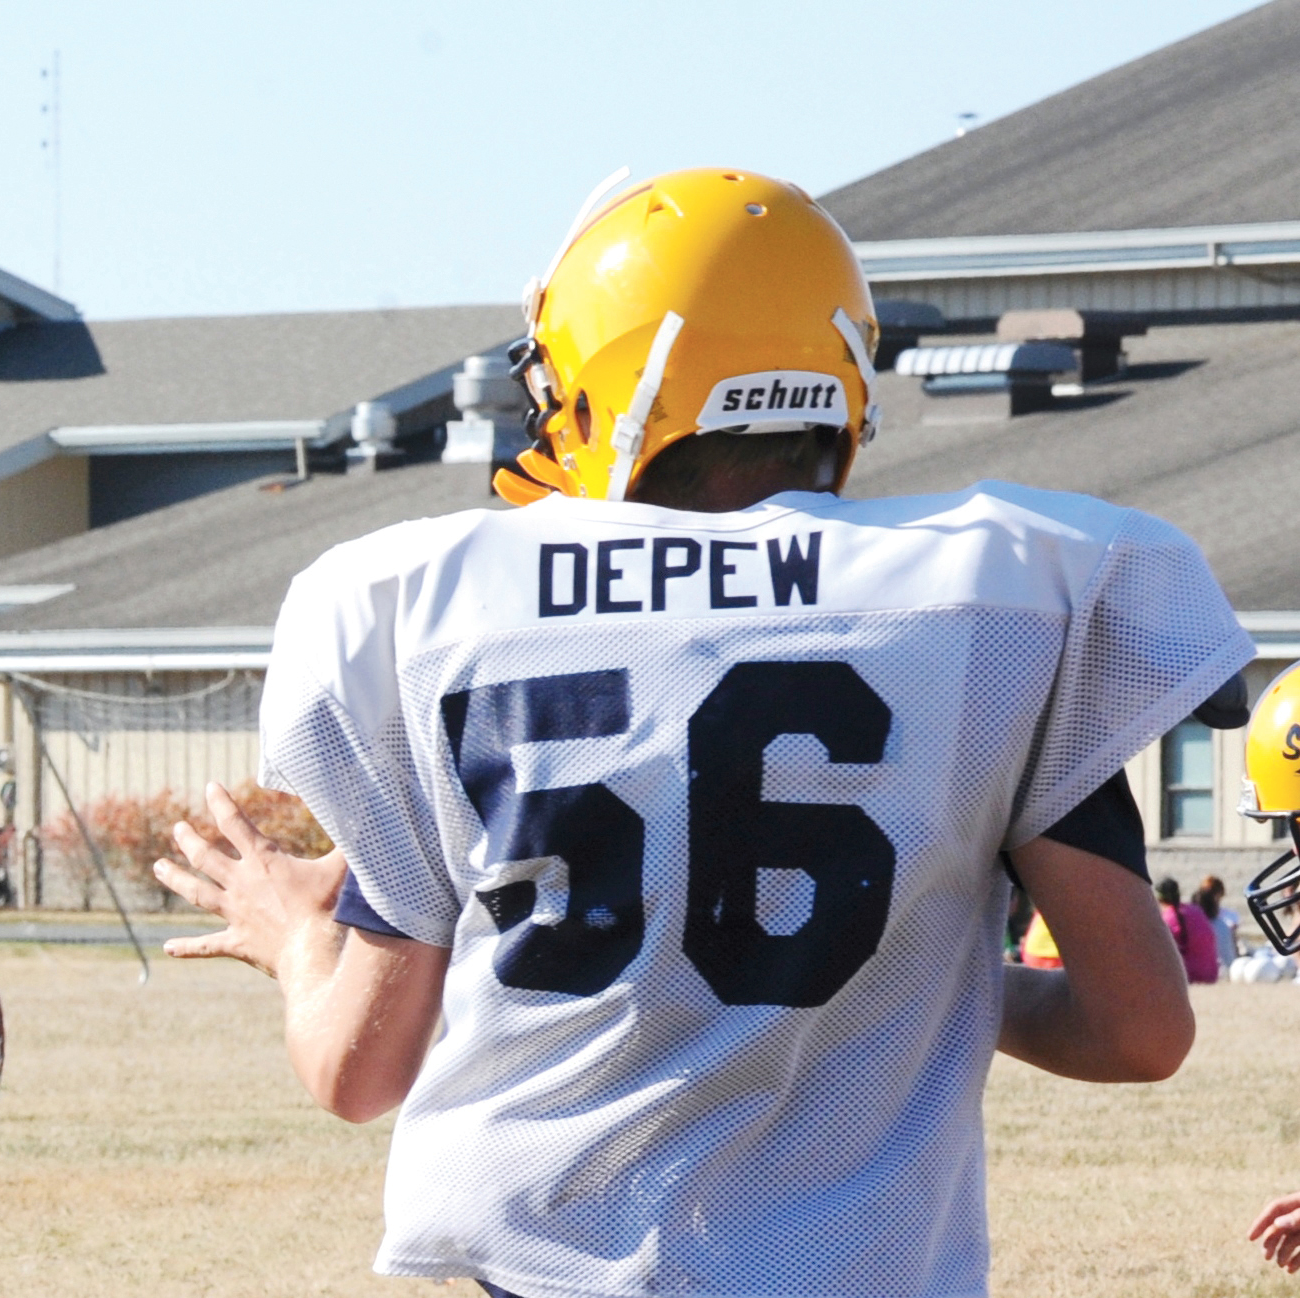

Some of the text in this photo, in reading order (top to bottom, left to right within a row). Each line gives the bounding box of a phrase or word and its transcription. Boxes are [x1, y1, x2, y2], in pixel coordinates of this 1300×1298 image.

[723, 379, 837, 412] schutt
[539, 531, 823, 618] DEPEW
[440, 660, 896, 1007] 56
